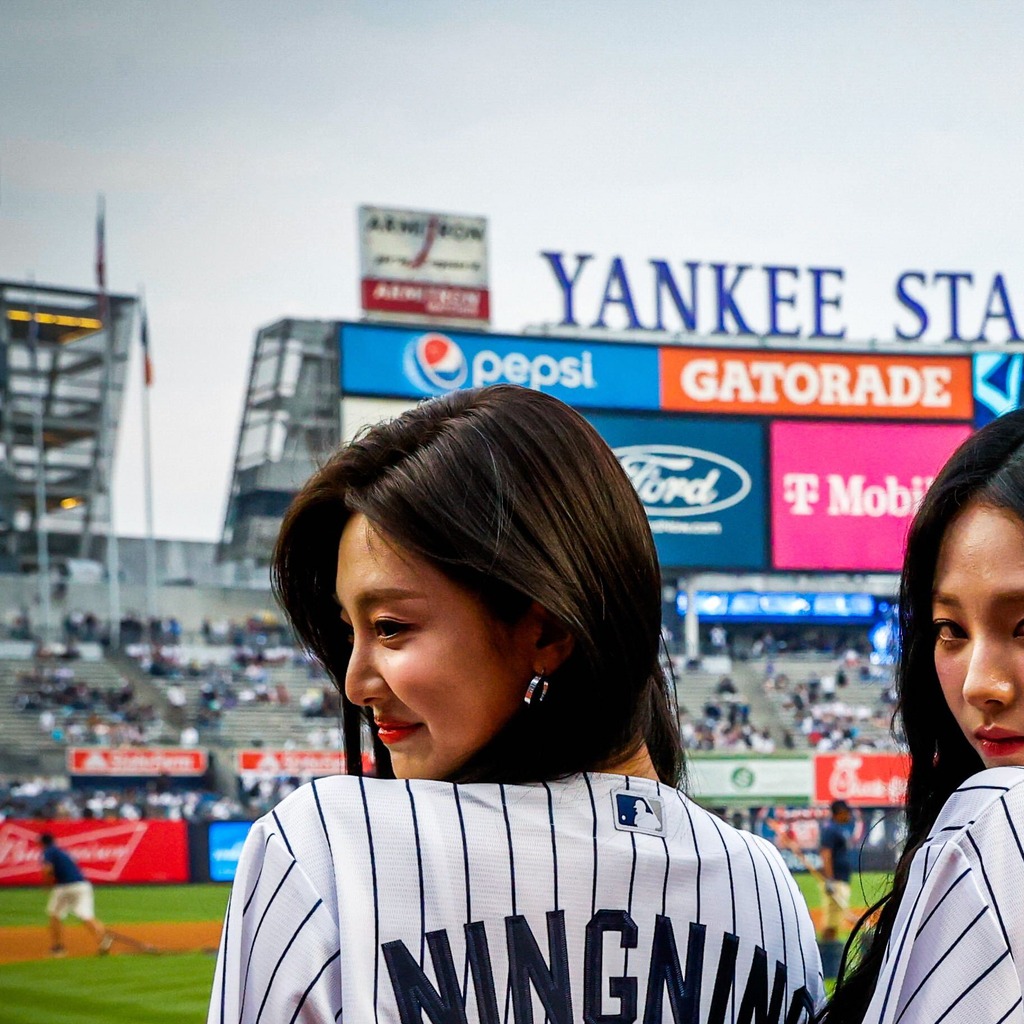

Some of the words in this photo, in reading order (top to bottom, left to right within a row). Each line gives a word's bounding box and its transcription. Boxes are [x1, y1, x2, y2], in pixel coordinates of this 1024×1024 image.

[541, 249, 846, 341] YANKEE
[472, 349, 597, 390] pepsi
[681, 359, 951, 408] GATORADE
[620, 455, 721, 506] Ford
[826, 473, 935, 518] Mobi
